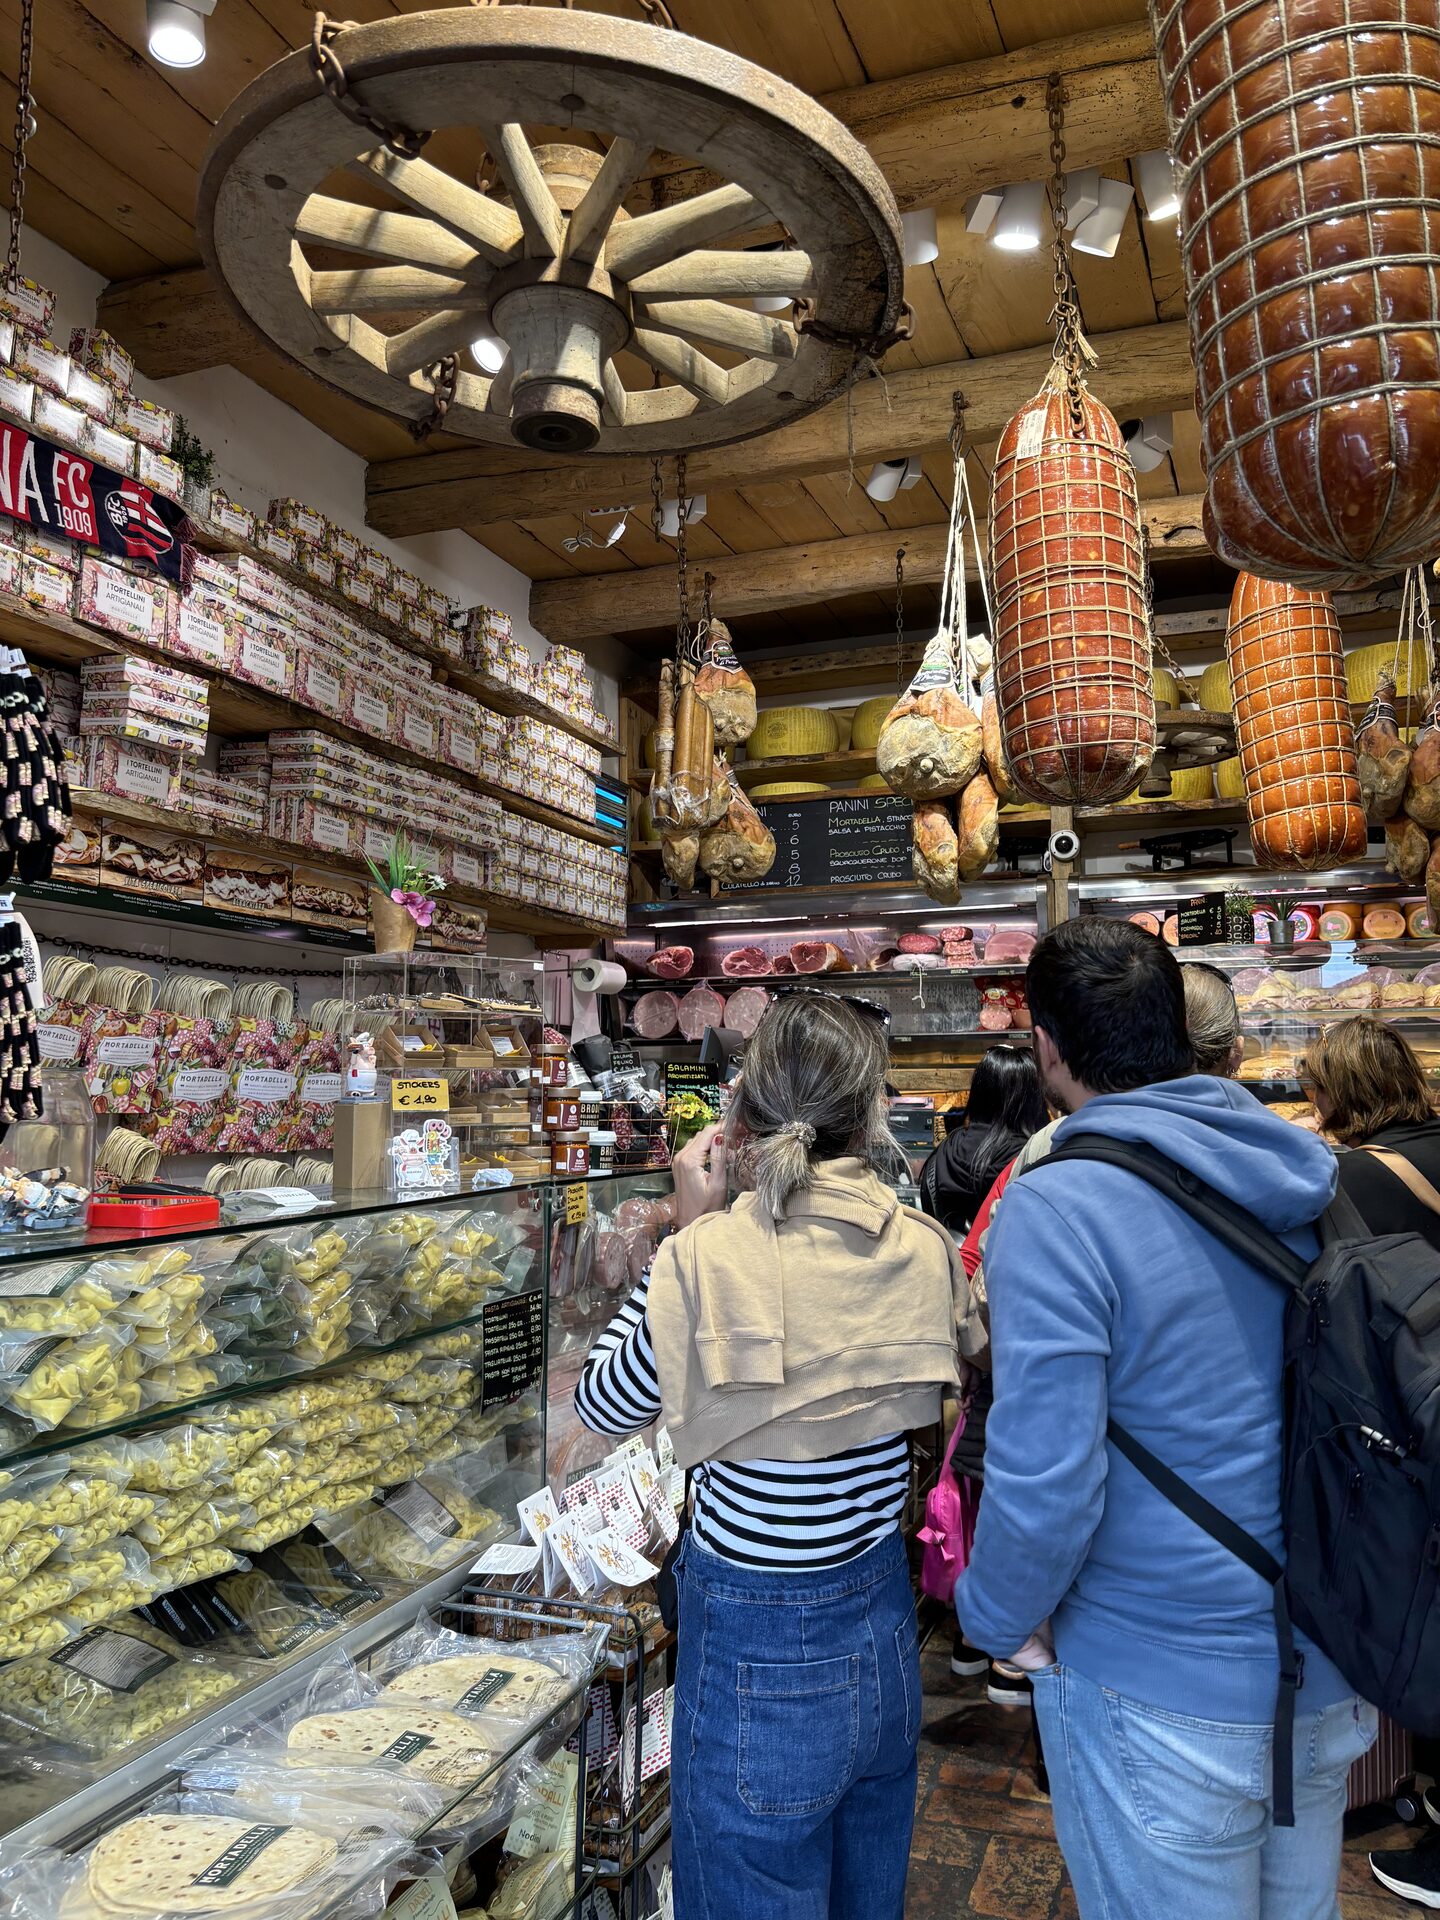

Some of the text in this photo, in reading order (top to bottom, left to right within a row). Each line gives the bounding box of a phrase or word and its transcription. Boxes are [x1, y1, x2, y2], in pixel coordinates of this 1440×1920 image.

[52, 451, 89, 509] FC
[108, 496, 123, 527] BFC
[53, 503, 93, 537] 1909
[110, 583, 146, 603] TORTELLINI
[106, 592, 145, 612] ARTIGIANALI
[190, 615, 219, 632] TORTELLINI
[187, 623, 219, 642] ARTIGIANALI
[253, 644, 280, 661] TORTELLINI
[249, 651, 280, 669] ARTIGIANALI
[316, 672, 336, 687] TORTELLINI
[129, 760, 163, 774] TORTELLINI
[125, 769, 162, 784] ARTIGIANALI
[829, 798, 868, 813] PANINI
[322, 818, 344, 830] TORTELLINI
[792, 819, 800, 831] 5
[828, 827, 851, 836] SALSA
[864, 824, 906, 833] PISTACCHIO
[790, 834, 800, 845] 6
[790, 849, 800, 860] 5
[788, 863, 801, 875] 8
[785, 874, 803, 887] 12
[830, 871, 902, 884] PROSCIUTTO CRUDO
[37, 1028, 77, 1042] MORTADELLA
[104, 1041, 149, 1049] MORTADELLA
[667, 1063, 707, 1072] SALAMINI
[244, 1075, 288, 1083] MORTADELLA
[397, 1081, 440, 1090] STICKERS
[398, 1094, 437, 1105] € 1,90
[457, 1671, 502, 1710] ORTADELLA
[199, 1825, 273, 1884] MORTADELLA
